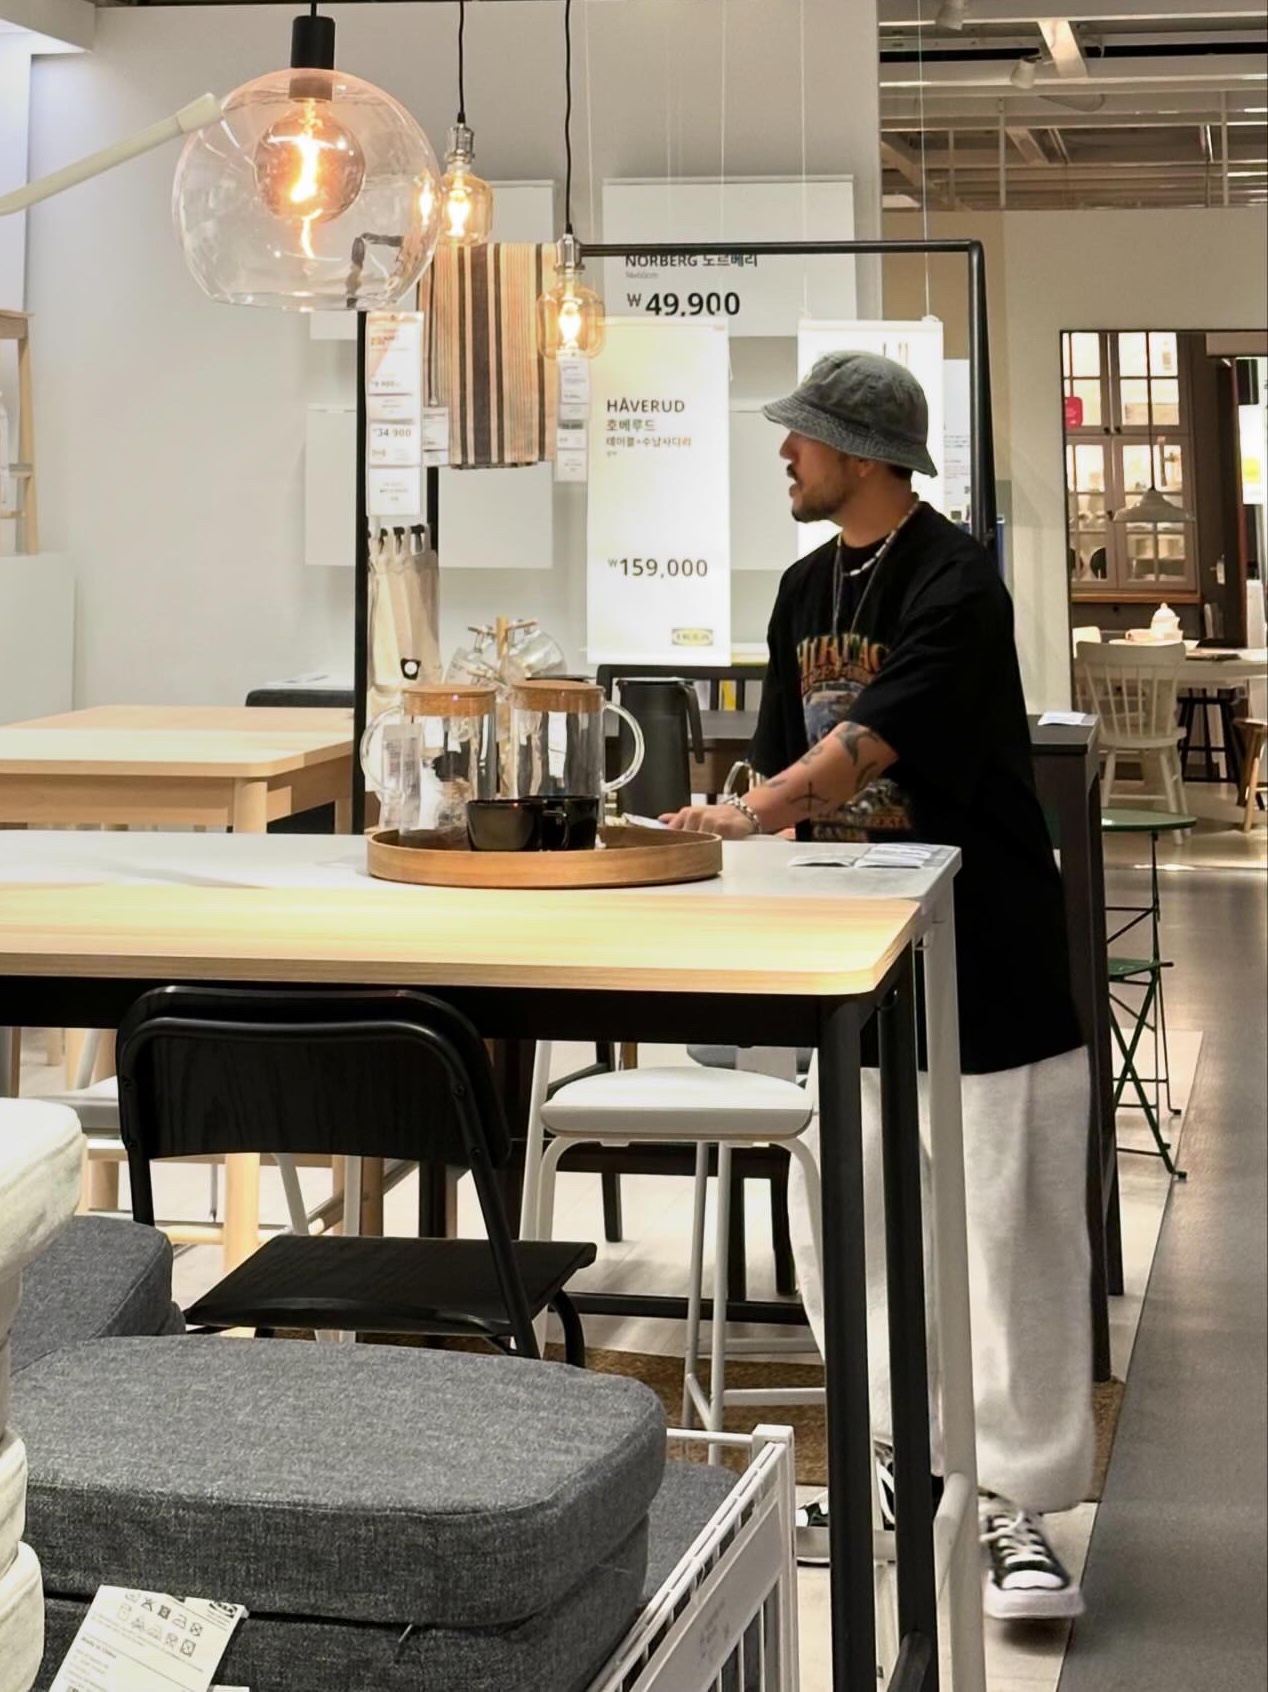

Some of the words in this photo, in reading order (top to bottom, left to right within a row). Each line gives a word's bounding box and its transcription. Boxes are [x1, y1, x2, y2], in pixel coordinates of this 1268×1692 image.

[625, 254, 698, 267] NORBERG
[702, 254, 758, 267] 노르베리
[607, 397, 685, 413] HÅVERUD
[606, 419, 655, 432] 호베루드
